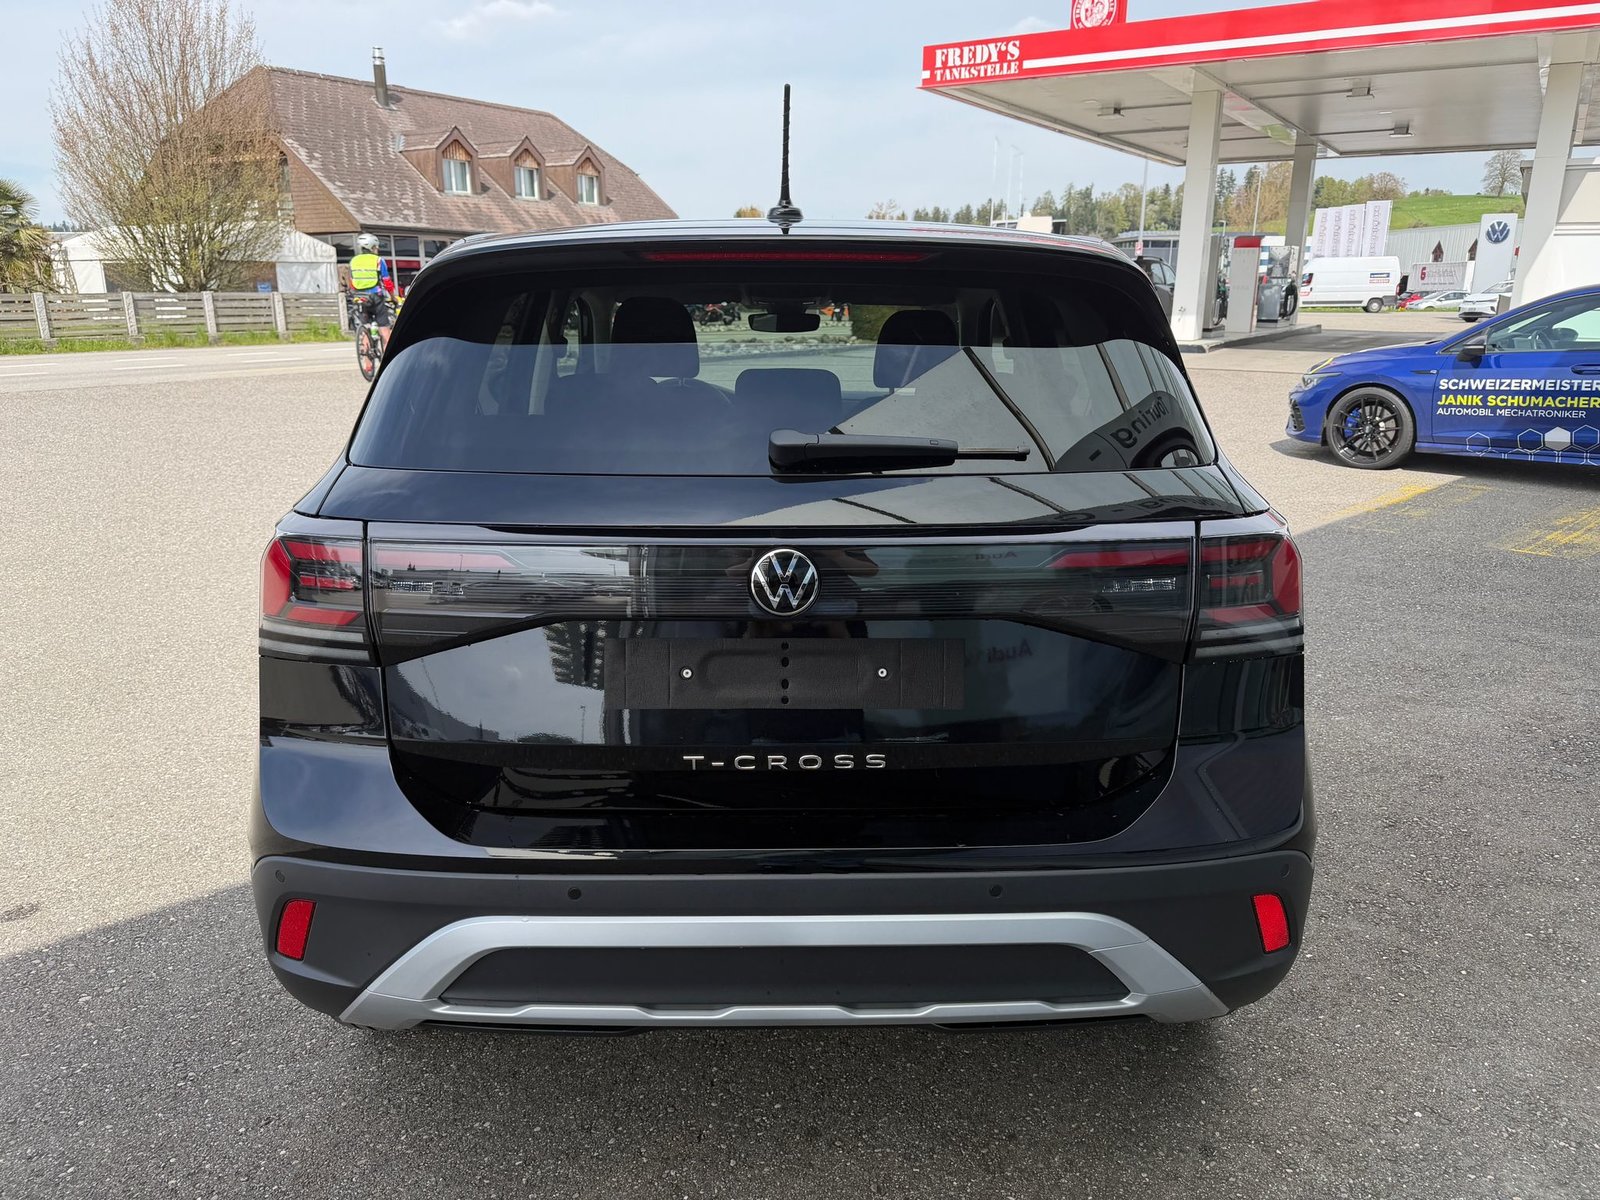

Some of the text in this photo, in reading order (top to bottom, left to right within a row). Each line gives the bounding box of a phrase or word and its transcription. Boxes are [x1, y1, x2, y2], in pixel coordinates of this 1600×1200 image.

[935, 61, 1019, 81] TANKSTELLE
[1438, 378, 1600, 391] SCHWEIZERMEISTER
[1437, 394, 1600, 408] JANIK SCHUMACHER
[1436, 407, 1586, 419] AUTOMOBIL MECHATRONIKER
[751, 548, 819, 616] VW
[682, 754, 887, 770] T-CROSS
